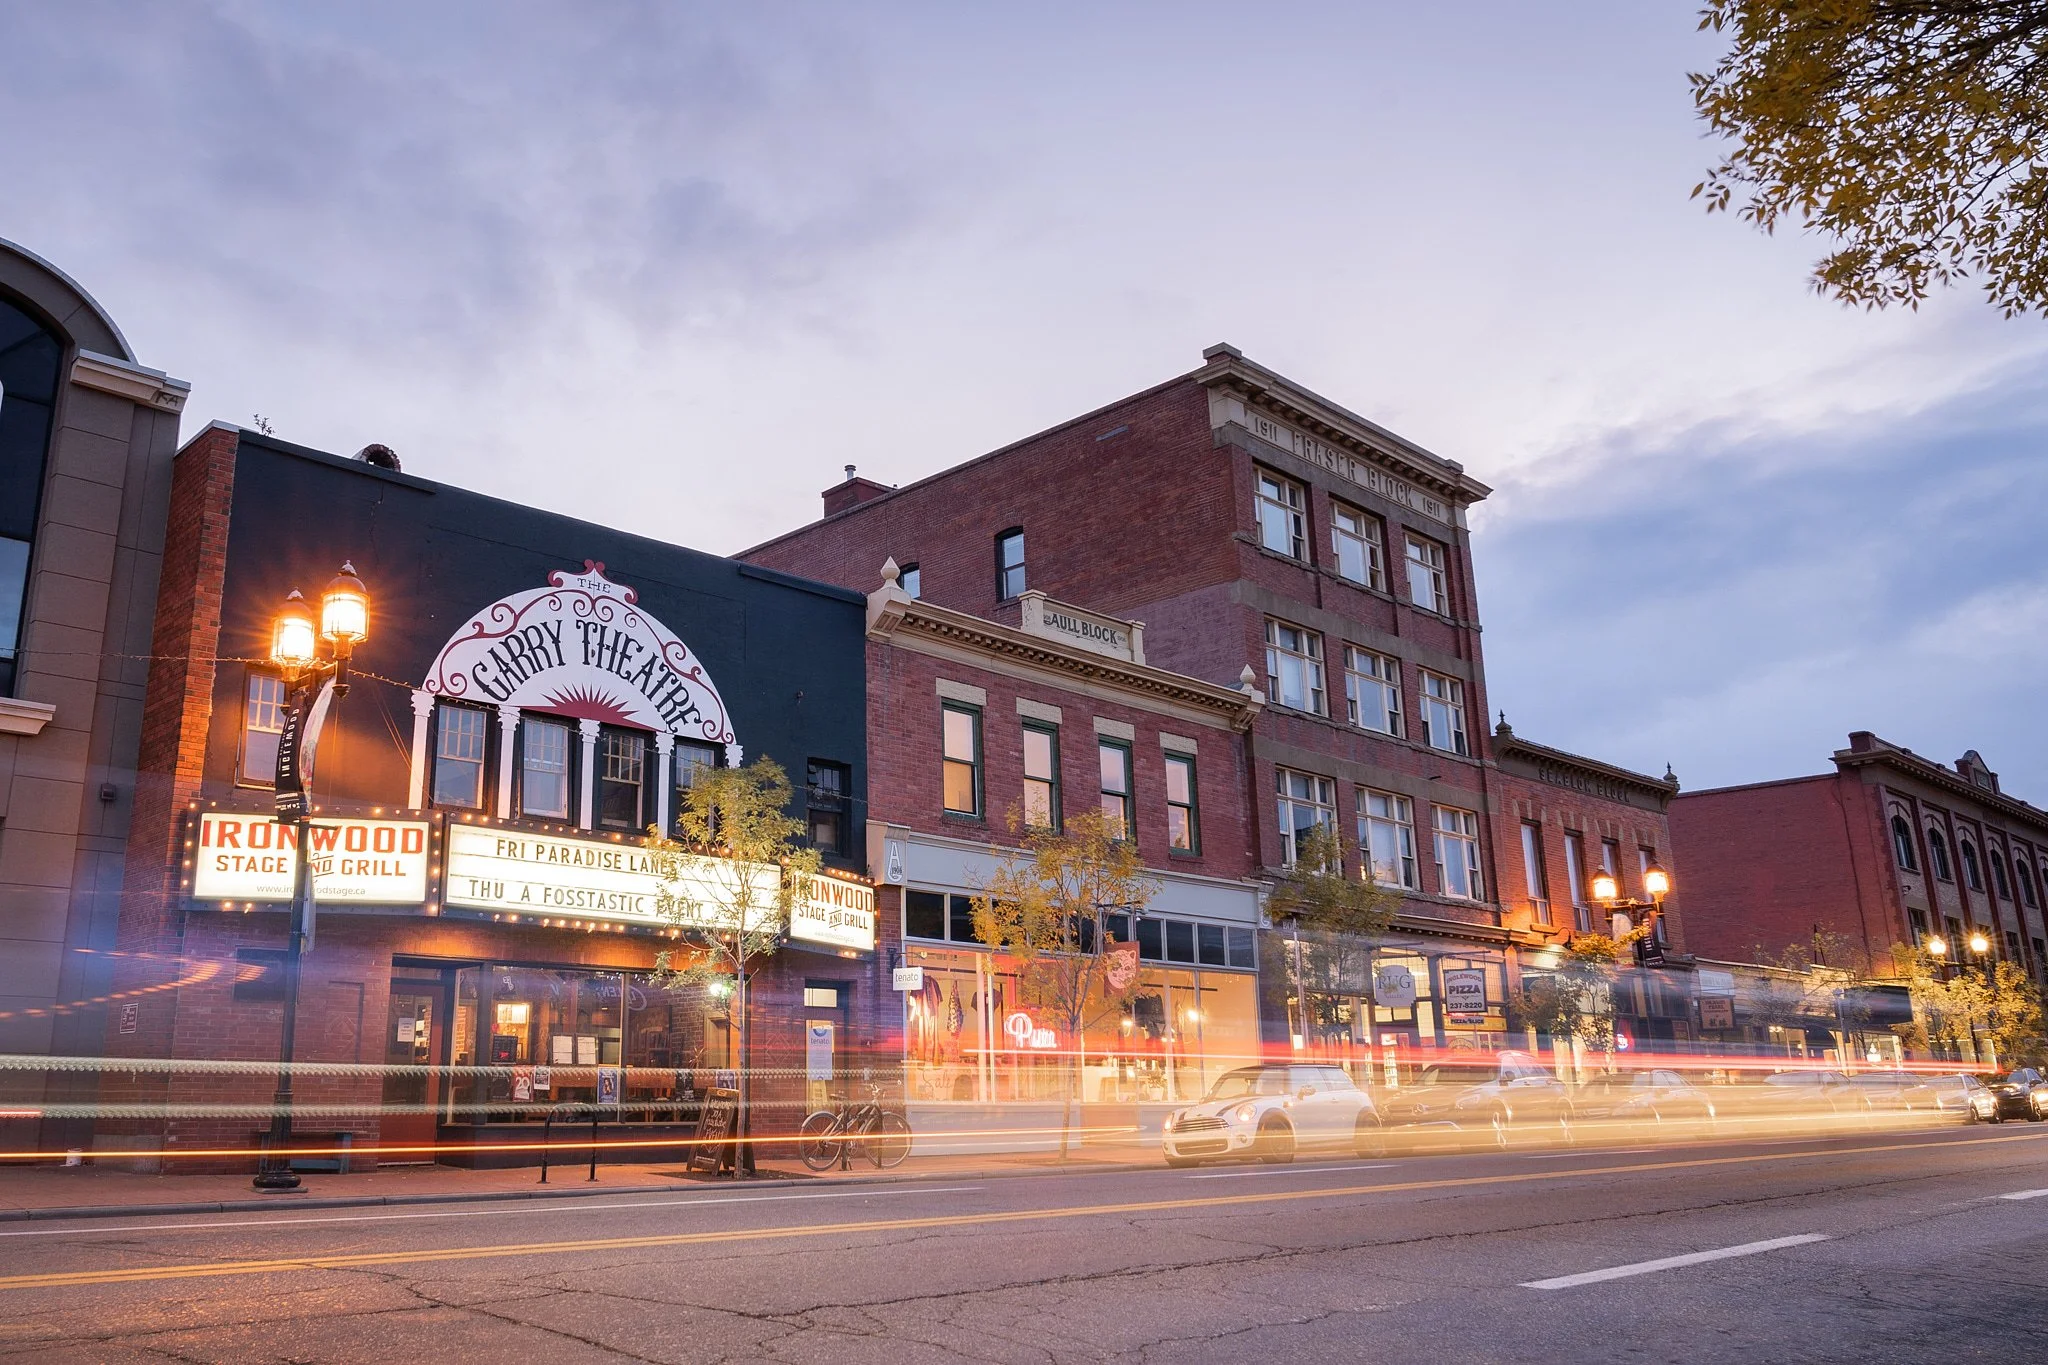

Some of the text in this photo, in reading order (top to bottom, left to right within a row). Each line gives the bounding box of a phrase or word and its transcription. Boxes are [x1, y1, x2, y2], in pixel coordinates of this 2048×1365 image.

[1255, 417, 1442, 518] 1911 FRASER BLOCK 1911
[577, 577, 611, 594] THE
[1047, 612, 1119, 646] AULL BLOCK
[471, 619, 704, 735] GARRY THEATRE
[201, 819, 424, 855] IRONWOOD
[215, 854, 407, 877] STAGE ND GRILL
[496, 839, 526, 859] FRI
[536, 844, 622, 870] PARADISE
[469, 879, 505, 899] THU
[520, 885, 531, 902] A
[543, 887, 645, 913] FOSSTASTIC
[798, 904, 868, 930] STAGE AND GRILL
[895, 972, 919, 982] tenato
[1448, 984, 1481, 995] PIZZA
